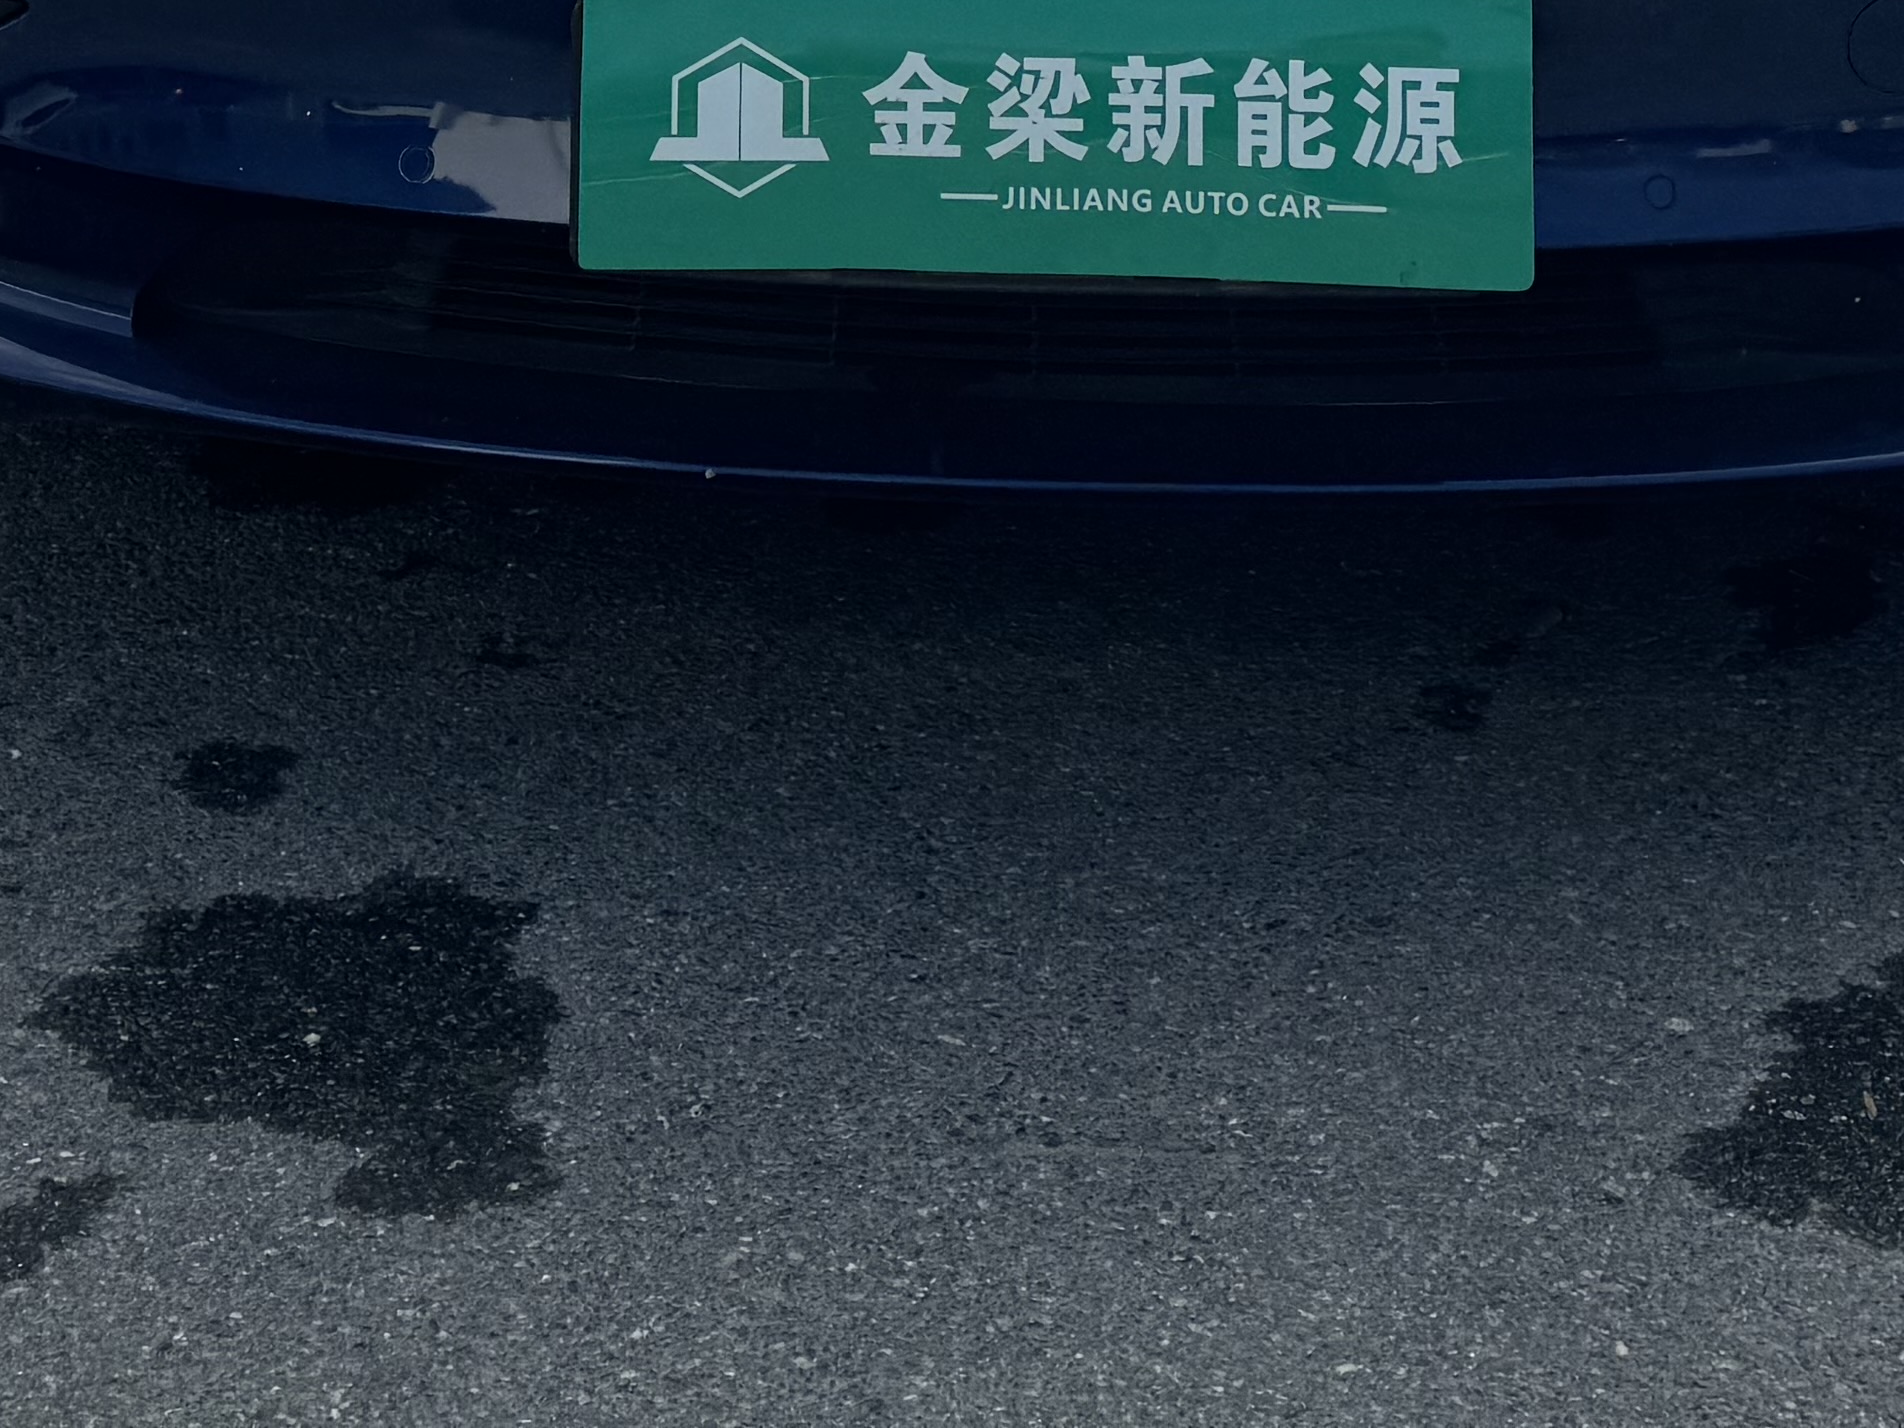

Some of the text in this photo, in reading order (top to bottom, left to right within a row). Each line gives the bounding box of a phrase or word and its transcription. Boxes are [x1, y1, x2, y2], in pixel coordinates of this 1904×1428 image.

[862, 51, 1464, 174] 金梁新能源
[1002, 186, 1322, 219] JINLIANG AUTO CAR
